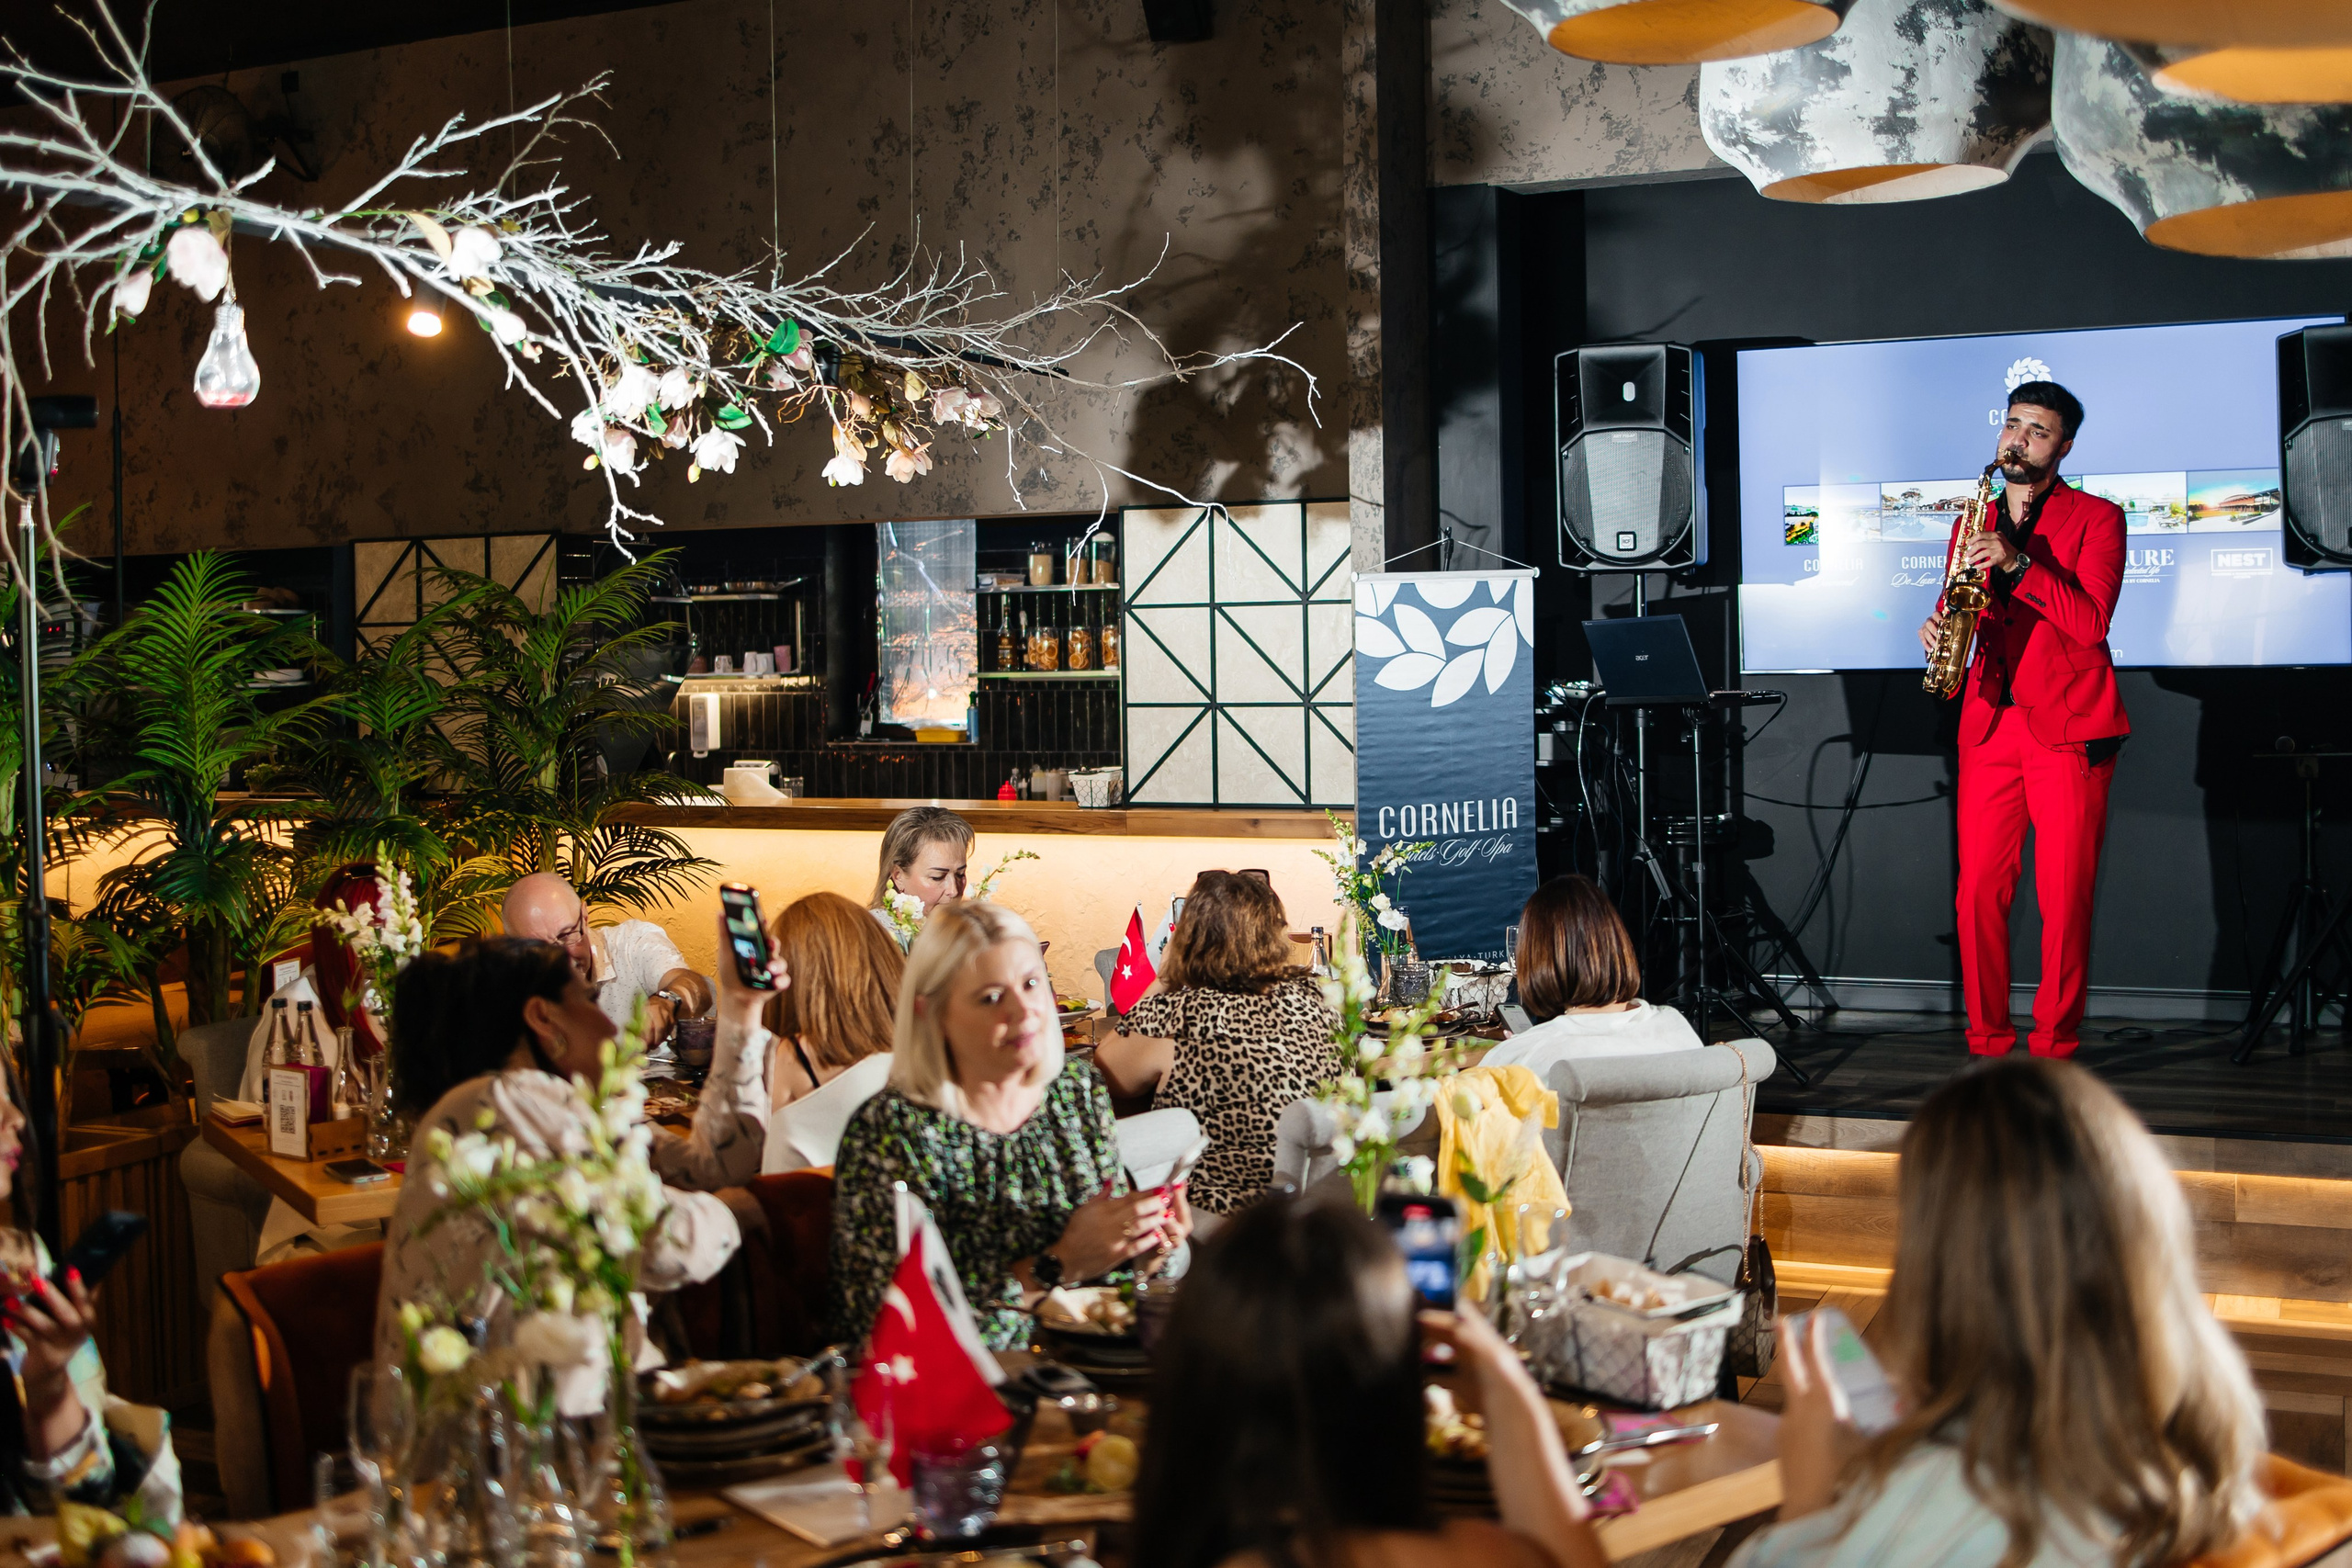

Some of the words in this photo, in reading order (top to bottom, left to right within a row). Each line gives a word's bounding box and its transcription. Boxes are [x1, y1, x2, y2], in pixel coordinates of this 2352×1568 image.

[2125, 548, 2175, 567] URE
[2217, 553, 2267, 568] NEST
[1378, 796, 1518, 839] CORNELIA
[1477, 950, 1510, 960] TURK
